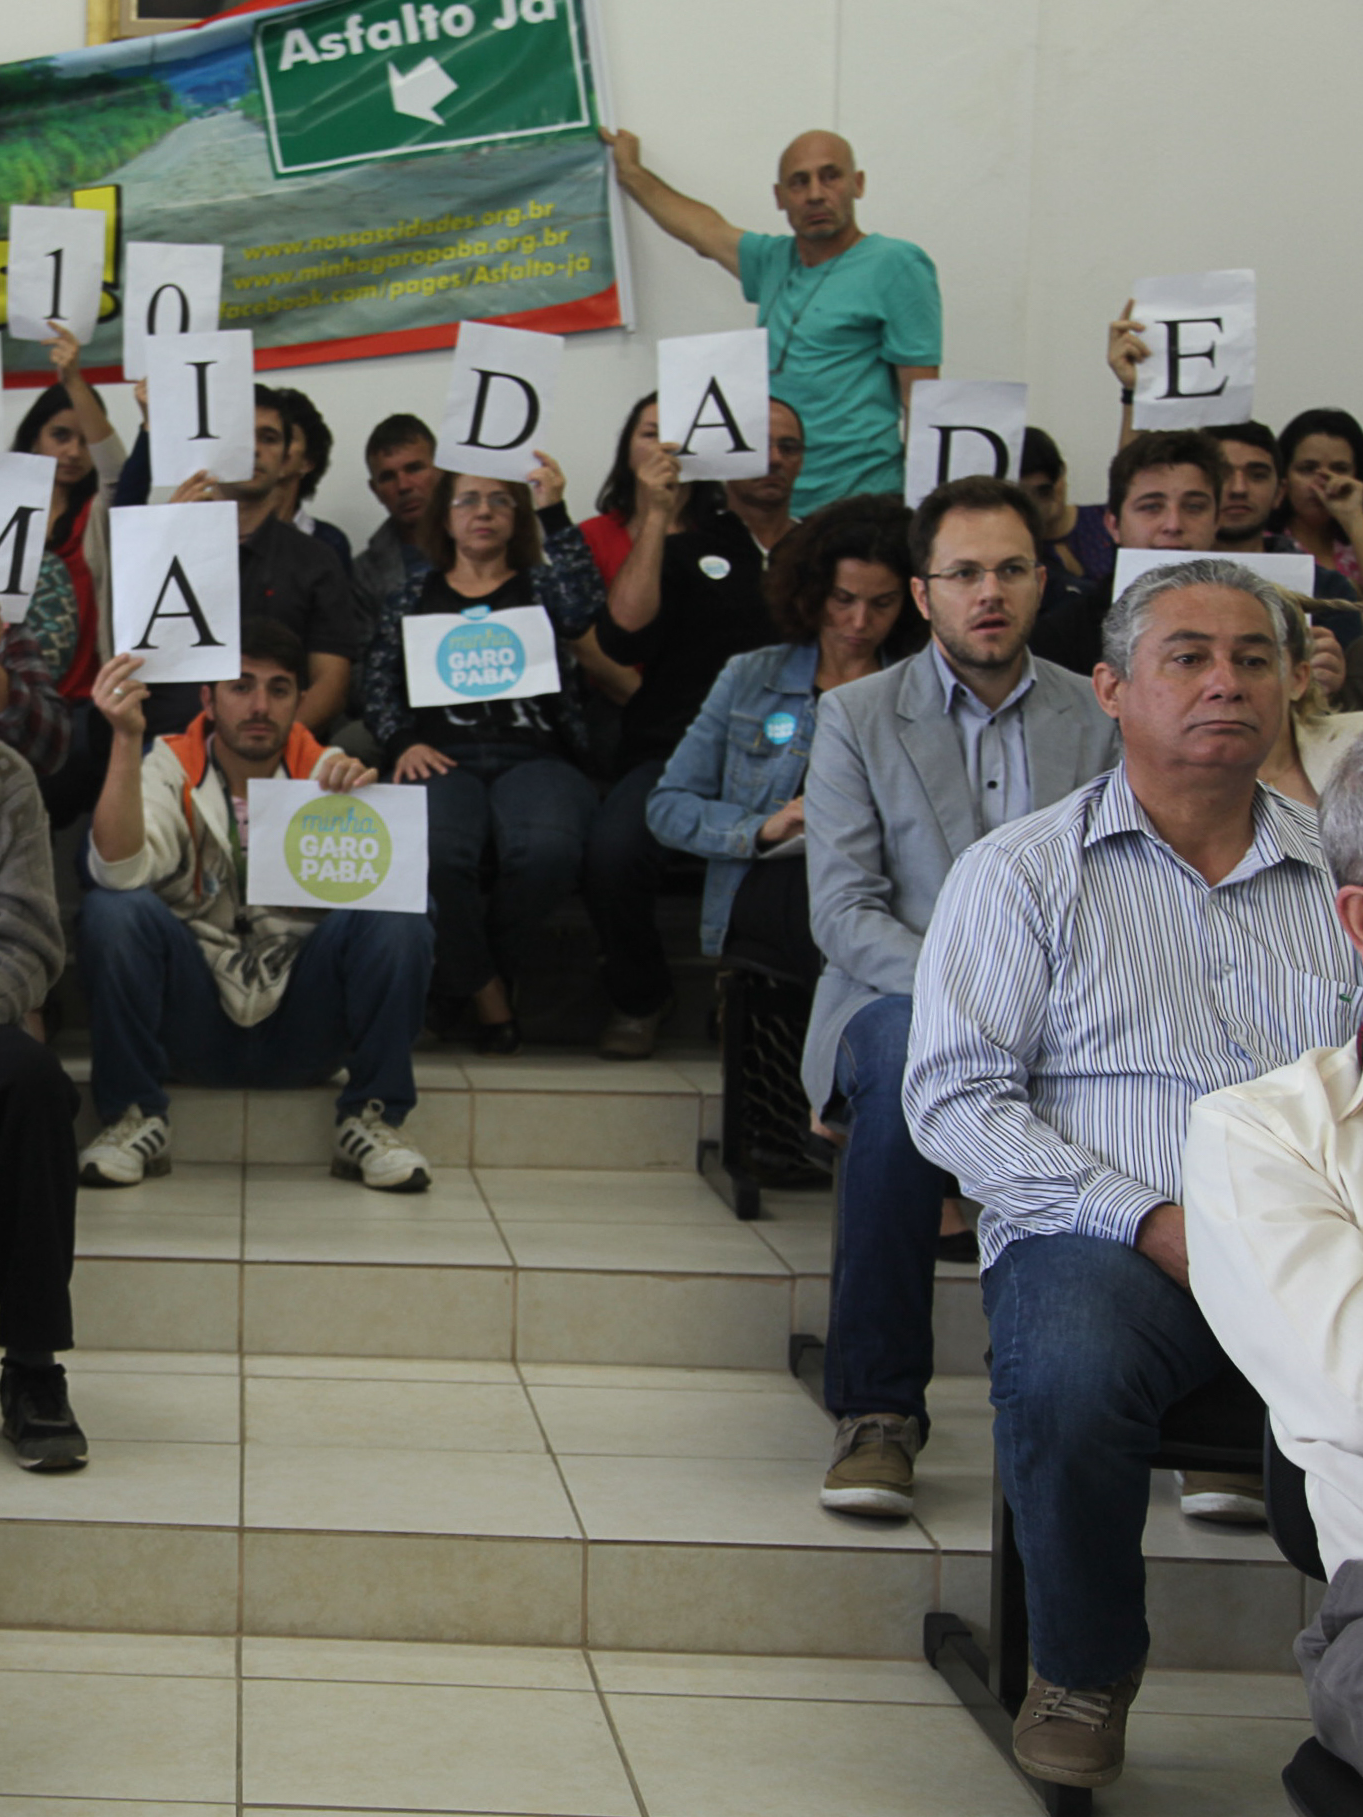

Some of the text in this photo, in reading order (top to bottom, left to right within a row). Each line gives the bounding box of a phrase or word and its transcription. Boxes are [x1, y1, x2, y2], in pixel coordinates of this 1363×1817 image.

[278, 3, 476, 71] Asfalto
[244, 200, 556, 262] www.nossascidades.org.br
[1154, 316, 1231, 401] E
[186, 360, 221, 440] I
[456, 367, 540, 451] D
[678, 376, 757, 455] A
[928, 424, 1010, 481] D
[131, 555, 228, 651] A
[447, 647, 517, 670] GARO
[450, 666, 518, 688] PABA
[299, 834, 380, 860] GARO
[301, 806, 378, 834] minha
[299, 858, 380, 884] PABA
